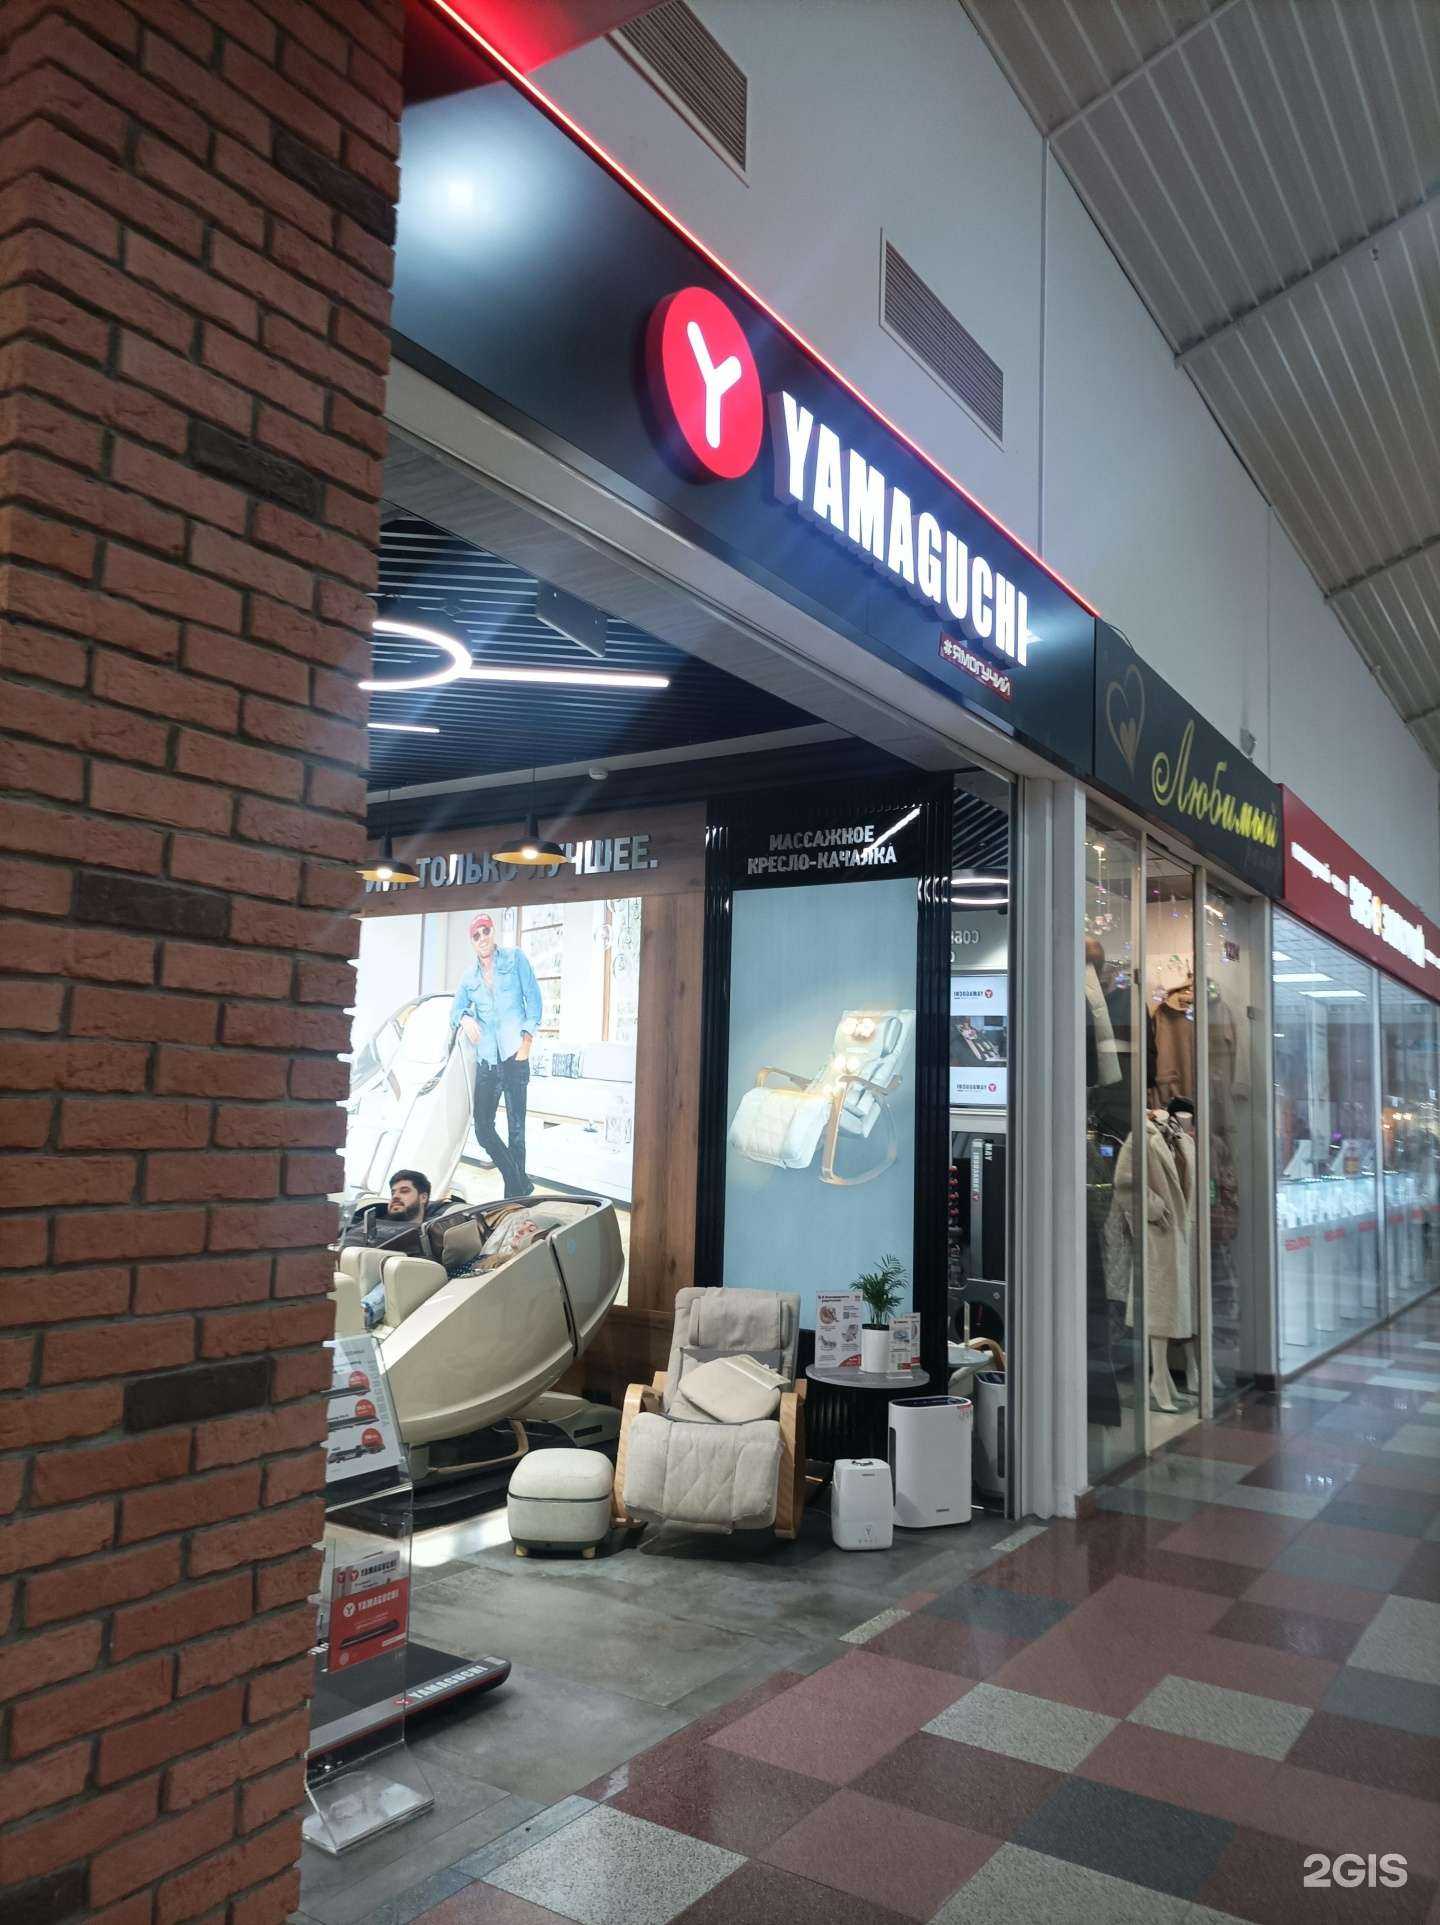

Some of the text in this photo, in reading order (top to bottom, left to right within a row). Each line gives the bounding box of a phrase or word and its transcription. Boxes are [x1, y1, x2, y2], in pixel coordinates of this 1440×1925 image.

[782, 390, 1027, 667] YAMAGUCHI
[1152, 719, 1279, 848] Любимый
[769, 825, 875, 852] МАССАЖНОЕ
[747, 846, 898, 875] КРЕСЛО-КАЧАЛКА
[407, 1665, 489, 1699] YAMAGUCHI
